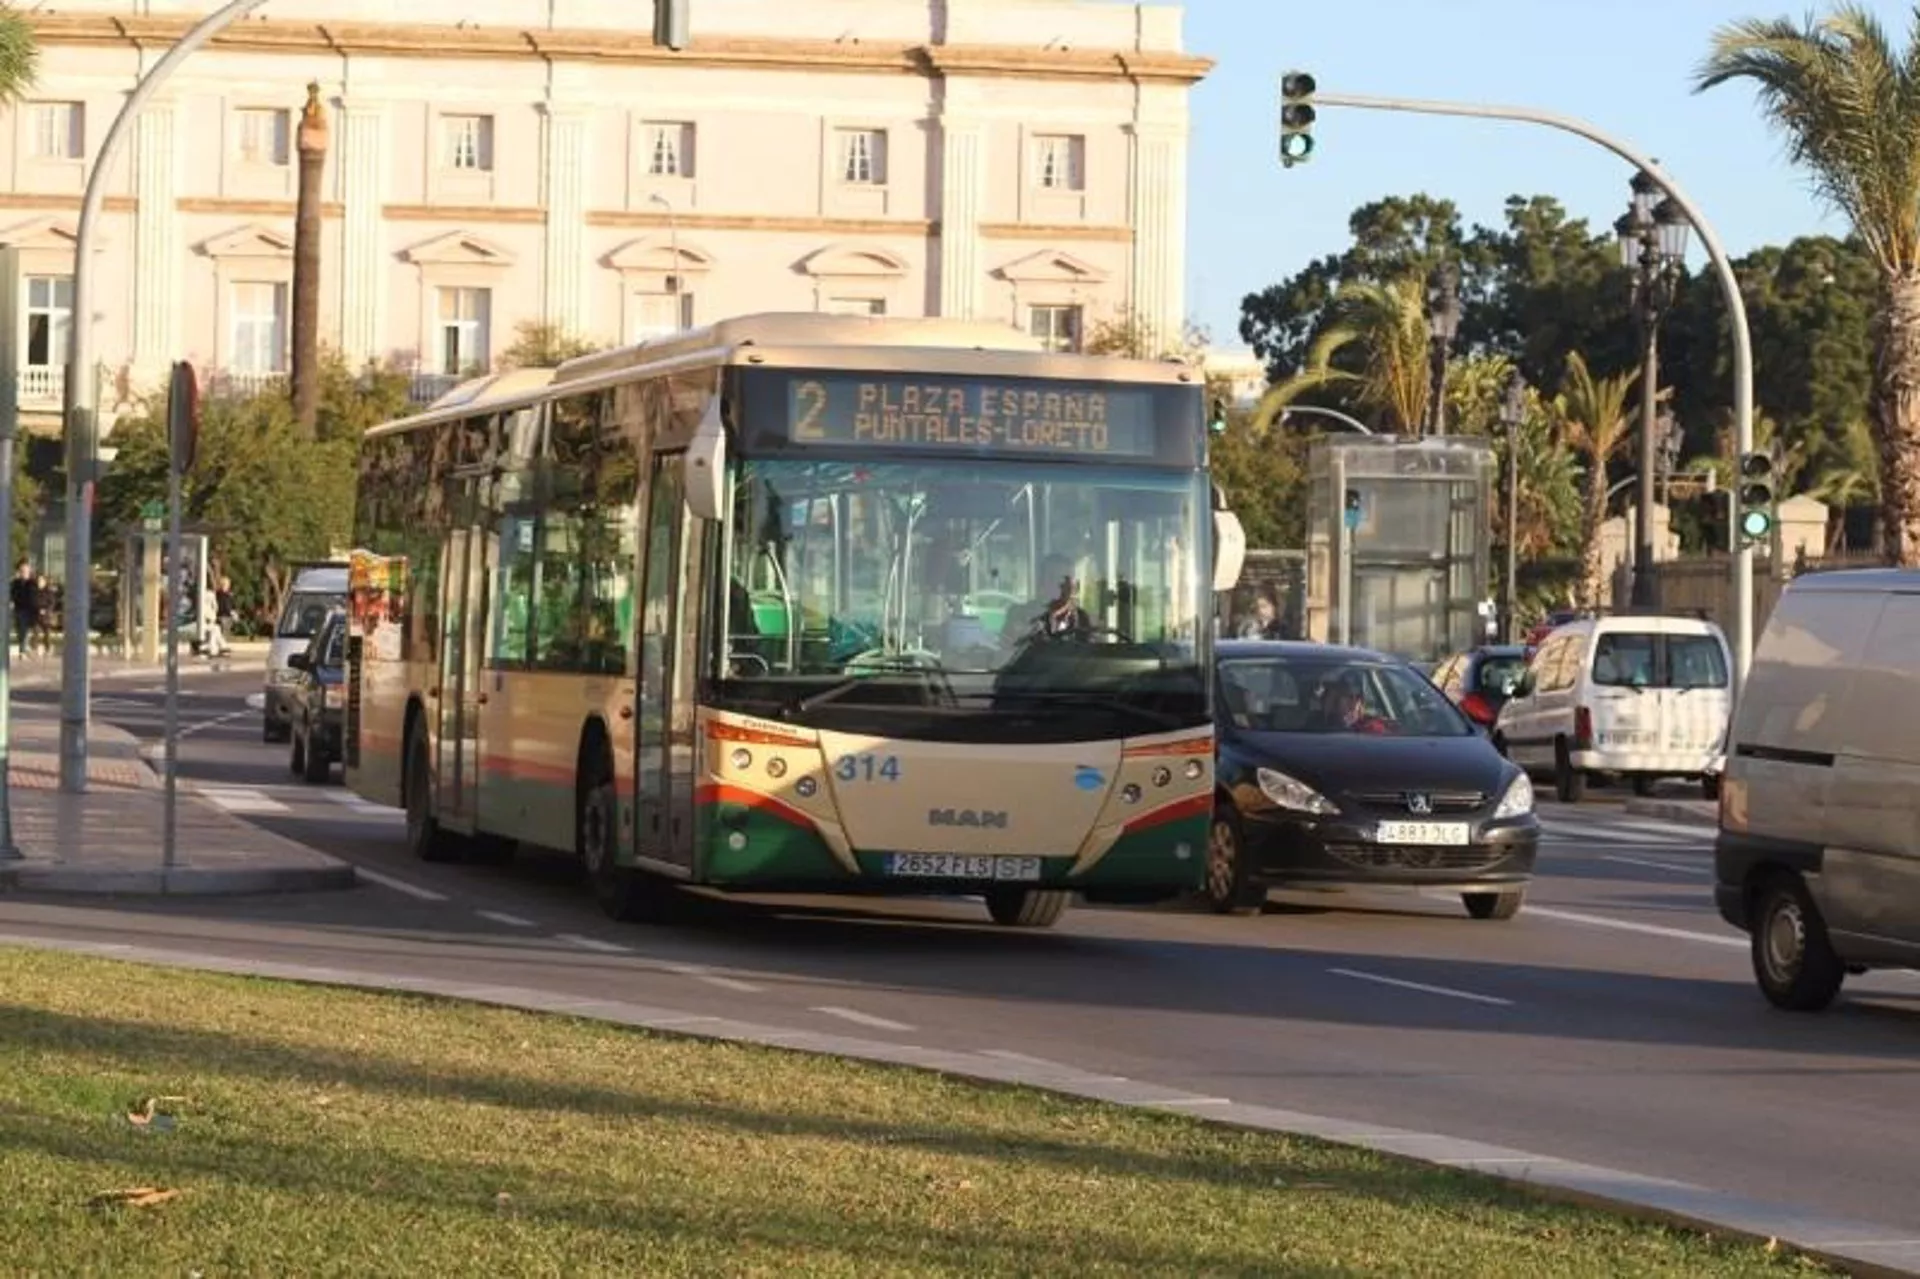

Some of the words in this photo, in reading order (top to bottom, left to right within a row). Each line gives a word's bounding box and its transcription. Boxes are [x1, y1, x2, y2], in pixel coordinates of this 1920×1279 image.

[795, 380, 827, 440] 2
[859, 383, 964, 414] PLAZA
[854, 413, 1108, 449] PUNTALES-LORETO
[836, 754, 902, 782] 314
[928, 808, 1008, 829] MAN
[1001, 858, 1037, 878] SP
